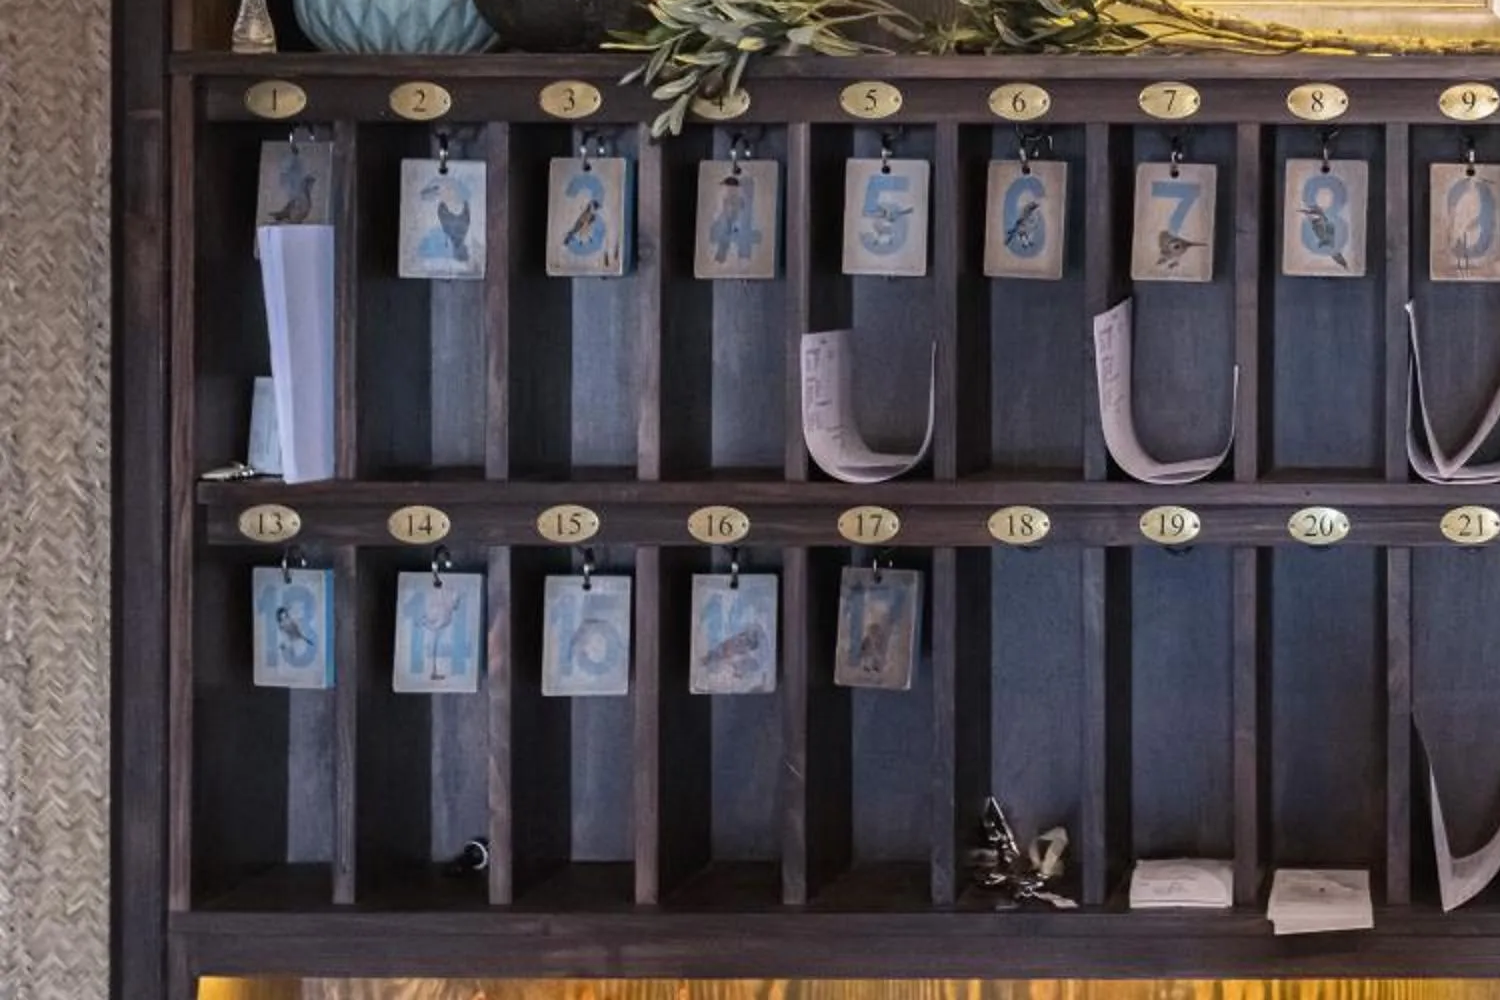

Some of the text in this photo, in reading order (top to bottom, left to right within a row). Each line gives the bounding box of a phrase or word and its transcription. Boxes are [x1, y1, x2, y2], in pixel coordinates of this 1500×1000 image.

[270, 88, 277, 111] 1
[412, 89, 426, 113] 2
[562, 88, 575, 112] 3
[864, 89, 877, 111] 5
[1012, 90, 1026, 113] 6
[1163, 90, 1177, 111] 7
[1311, 91, 1324, 112] 8
[1461, 91, 1476, 112] 9
[419, 176, 472, 260] 2
[565, 174, 606, 255] 3
[860, 175, 909, 254] 5
[1003, 175, 1046, 259] 6
[1151, 181, 1200, 234] 7
[1301, 175, 1348, 255] 8
[257, 513, 283, 536] 13
[406, 514, 433, 536] 14
[556, 514, 581, 535] 15
[705, 515, 733, 536] 16
[856, 514, 882, 536] 17
[1007, 514, 1033, 536] 18
[1158, 514, 1185, 536] 19
[1303, 514, 1333, 536] 20
[1458, 515, 1485, 536] 21
[256, 583, 317, 668] 13
